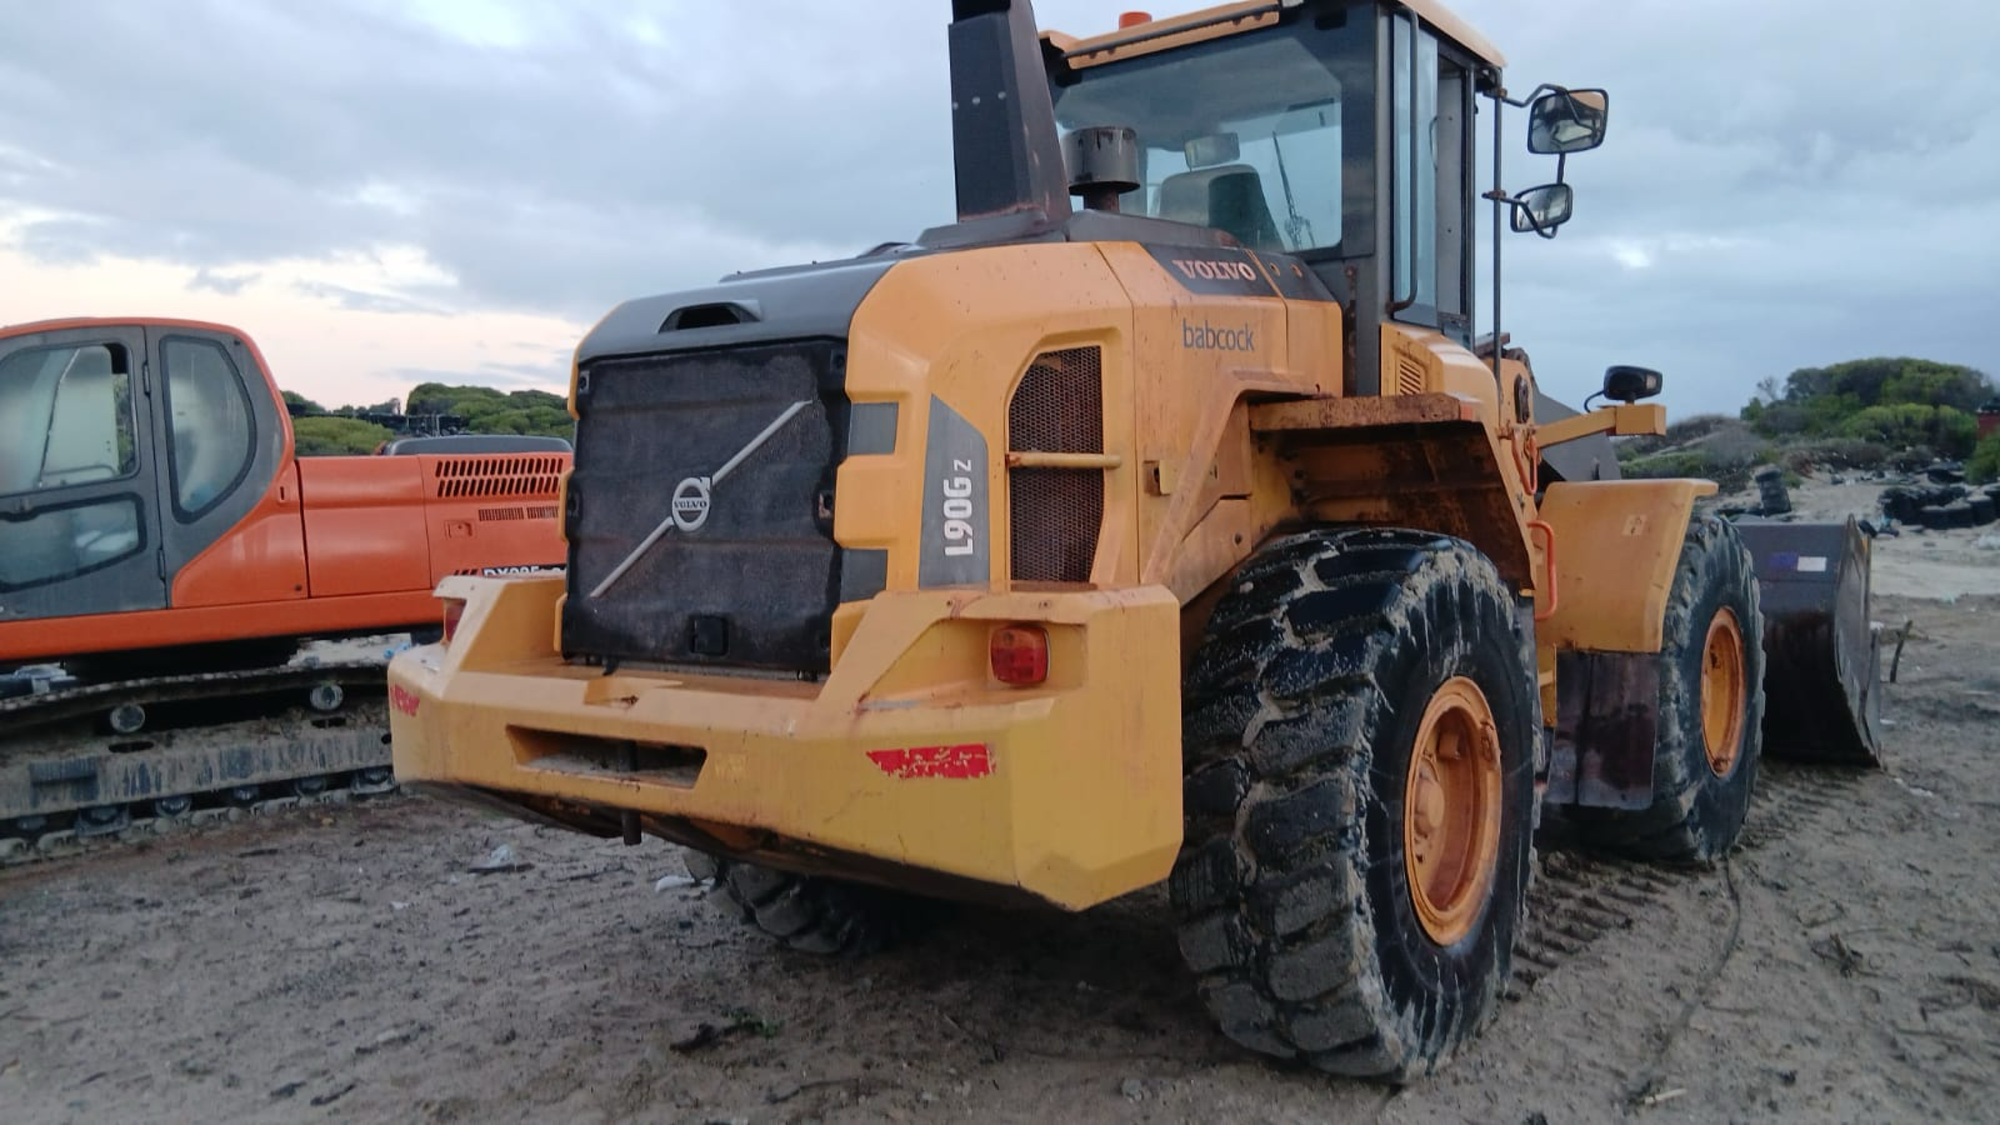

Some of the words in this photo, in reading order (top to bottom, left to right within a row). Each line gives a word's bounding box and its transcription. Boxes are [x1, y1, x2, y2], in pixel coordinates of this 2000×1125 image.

[1172, 259, 1257, 281] VOLVO
[1182, 318, 1255, 351] babcock
[673, 500, 708, 509] VOLVO
